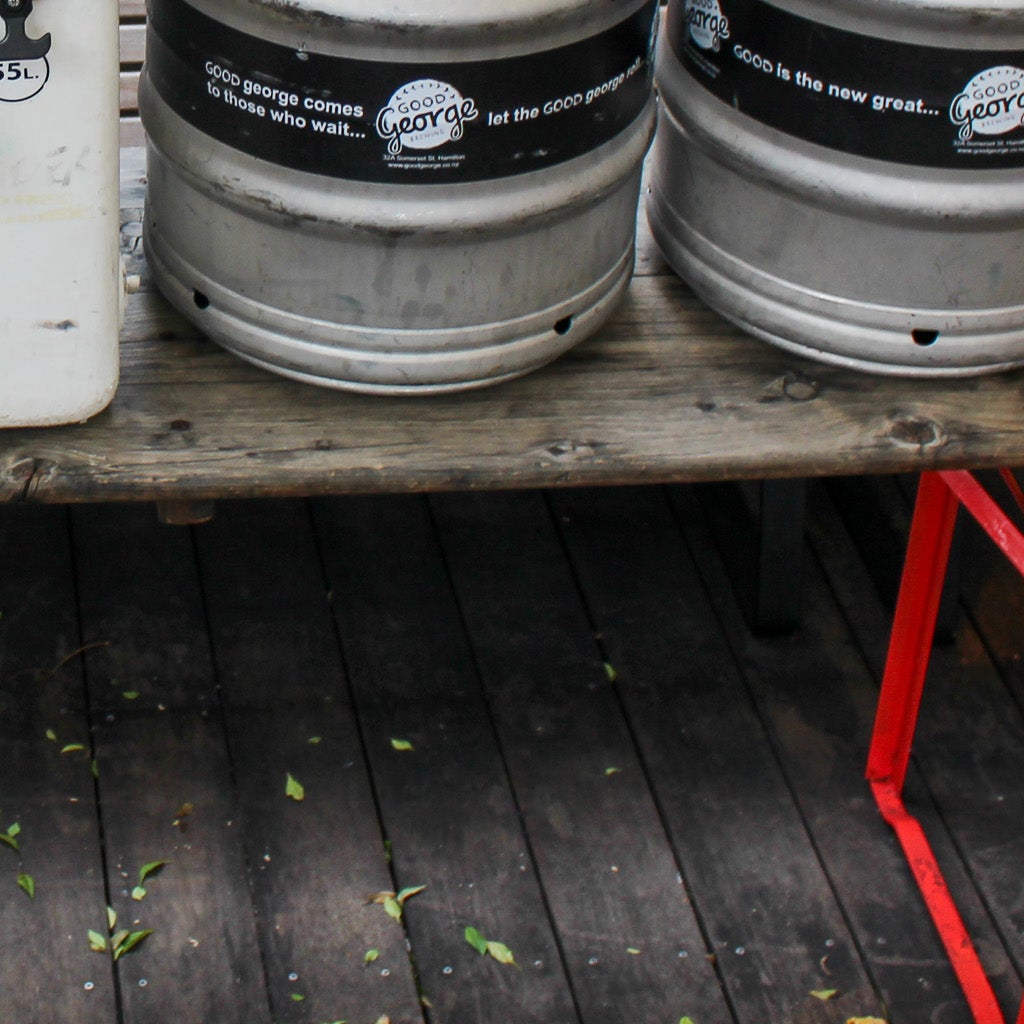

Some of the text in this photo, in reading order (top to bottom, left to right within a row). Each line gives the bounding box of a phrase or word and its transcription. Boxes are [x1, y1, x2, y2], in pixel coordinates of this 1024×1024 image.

[205, 61, 364, 118] GOOD george comes
[398, 94, 446, 114] GOOD
[488, 111, 510, 127] let
[513, 107, 540, 123] the
[543, 92, 584, 116] GOOD
[585, 72, 625, 105] george
[733, 44, 774, 74] GOOD
[777, 62, 791, 81] is
[795, 70, 824, 93] the
[828, 82, 868, 104] new
[872, 94, 940, 116] great...
[972, 80, 1021, 100] GOOD
[207, 81, 366, 139] to those who wait...
[377, 98, 479, 155] George
